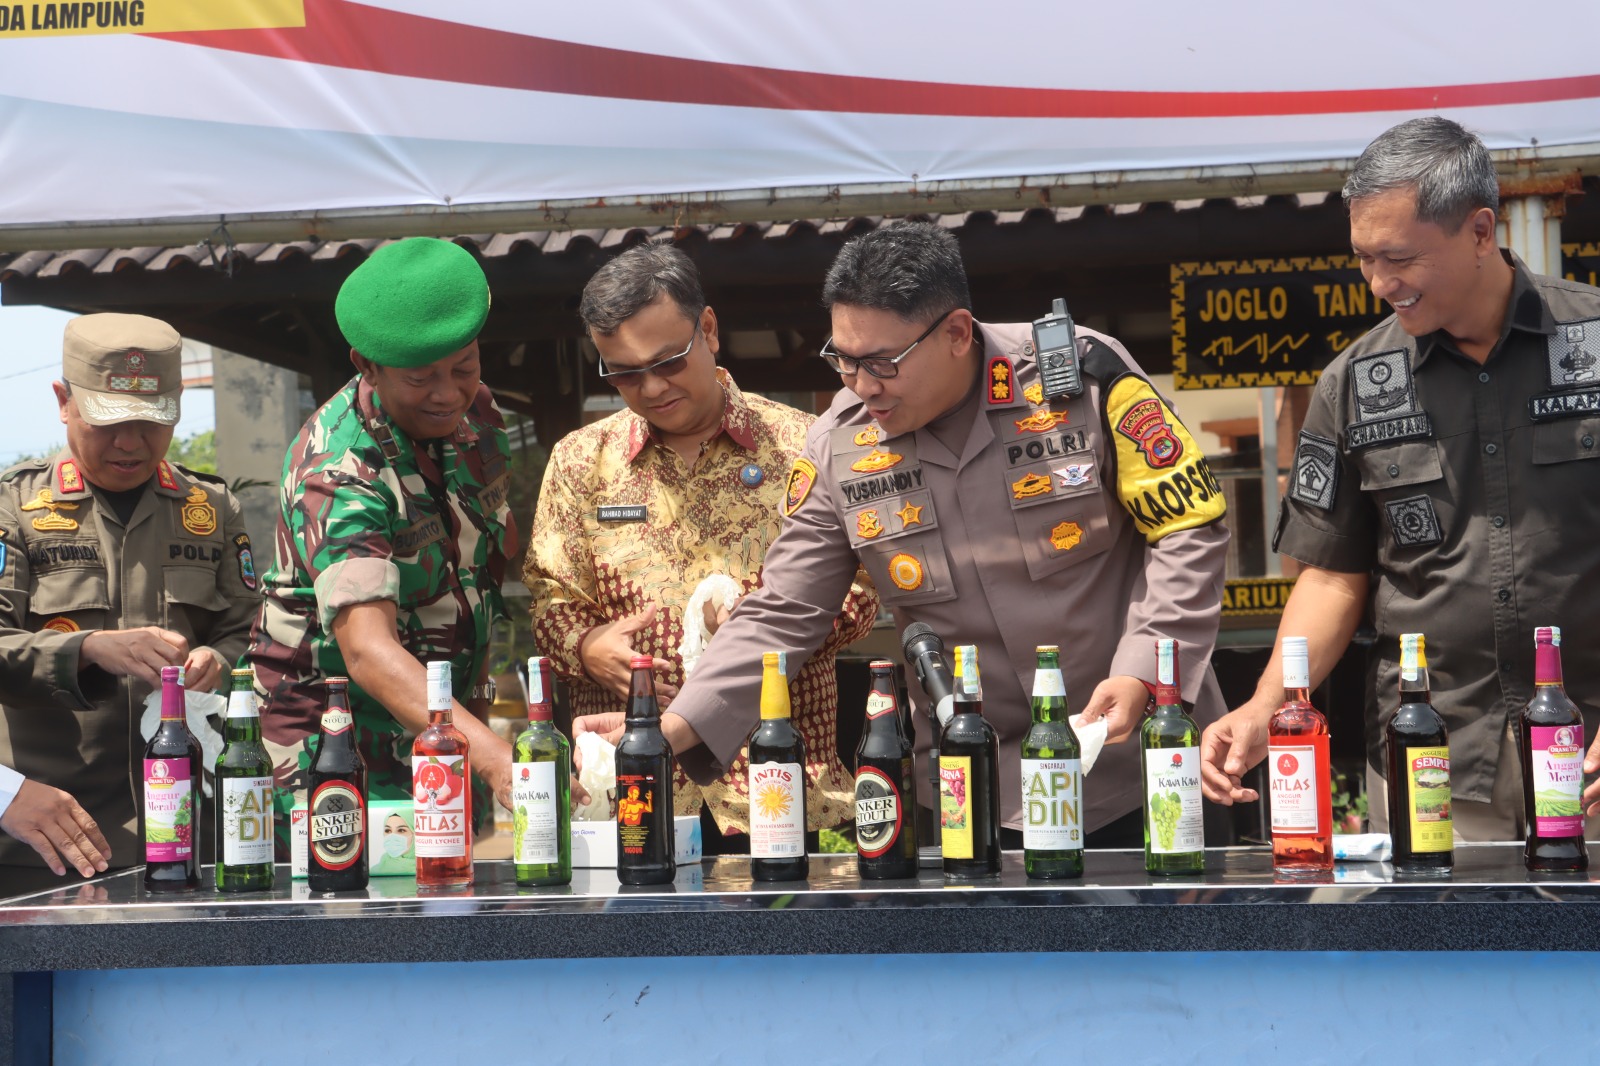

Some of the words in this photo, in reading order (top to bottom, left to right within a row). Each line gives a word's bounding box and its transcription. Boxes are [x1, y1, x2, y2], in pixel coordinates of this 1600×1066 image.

[32, 0, 145, 30] LAMPUNG
[1200, 286, 1287, 322] JOGLO
[1538, 392, 1600, 413] KALAP
[1008, 430, 1086, 464] POLRI
[1040, 762, 1066, 770] SINGARAJA
[754, 768, 793, 784] INTIS
[1029, 770, 1078, 798] API
[1549, 771, 1581, 783] Merah
[1272, 778, 1311, 792] ATLAS
[528, 790, 550, 800] KAWA
[313, 812, 361, 828] ANKER
[1029, 799, 1079, 826] DIN
[315, 822, 357, 838] STOUT
[415, 815, 460, 831] ATLAS
